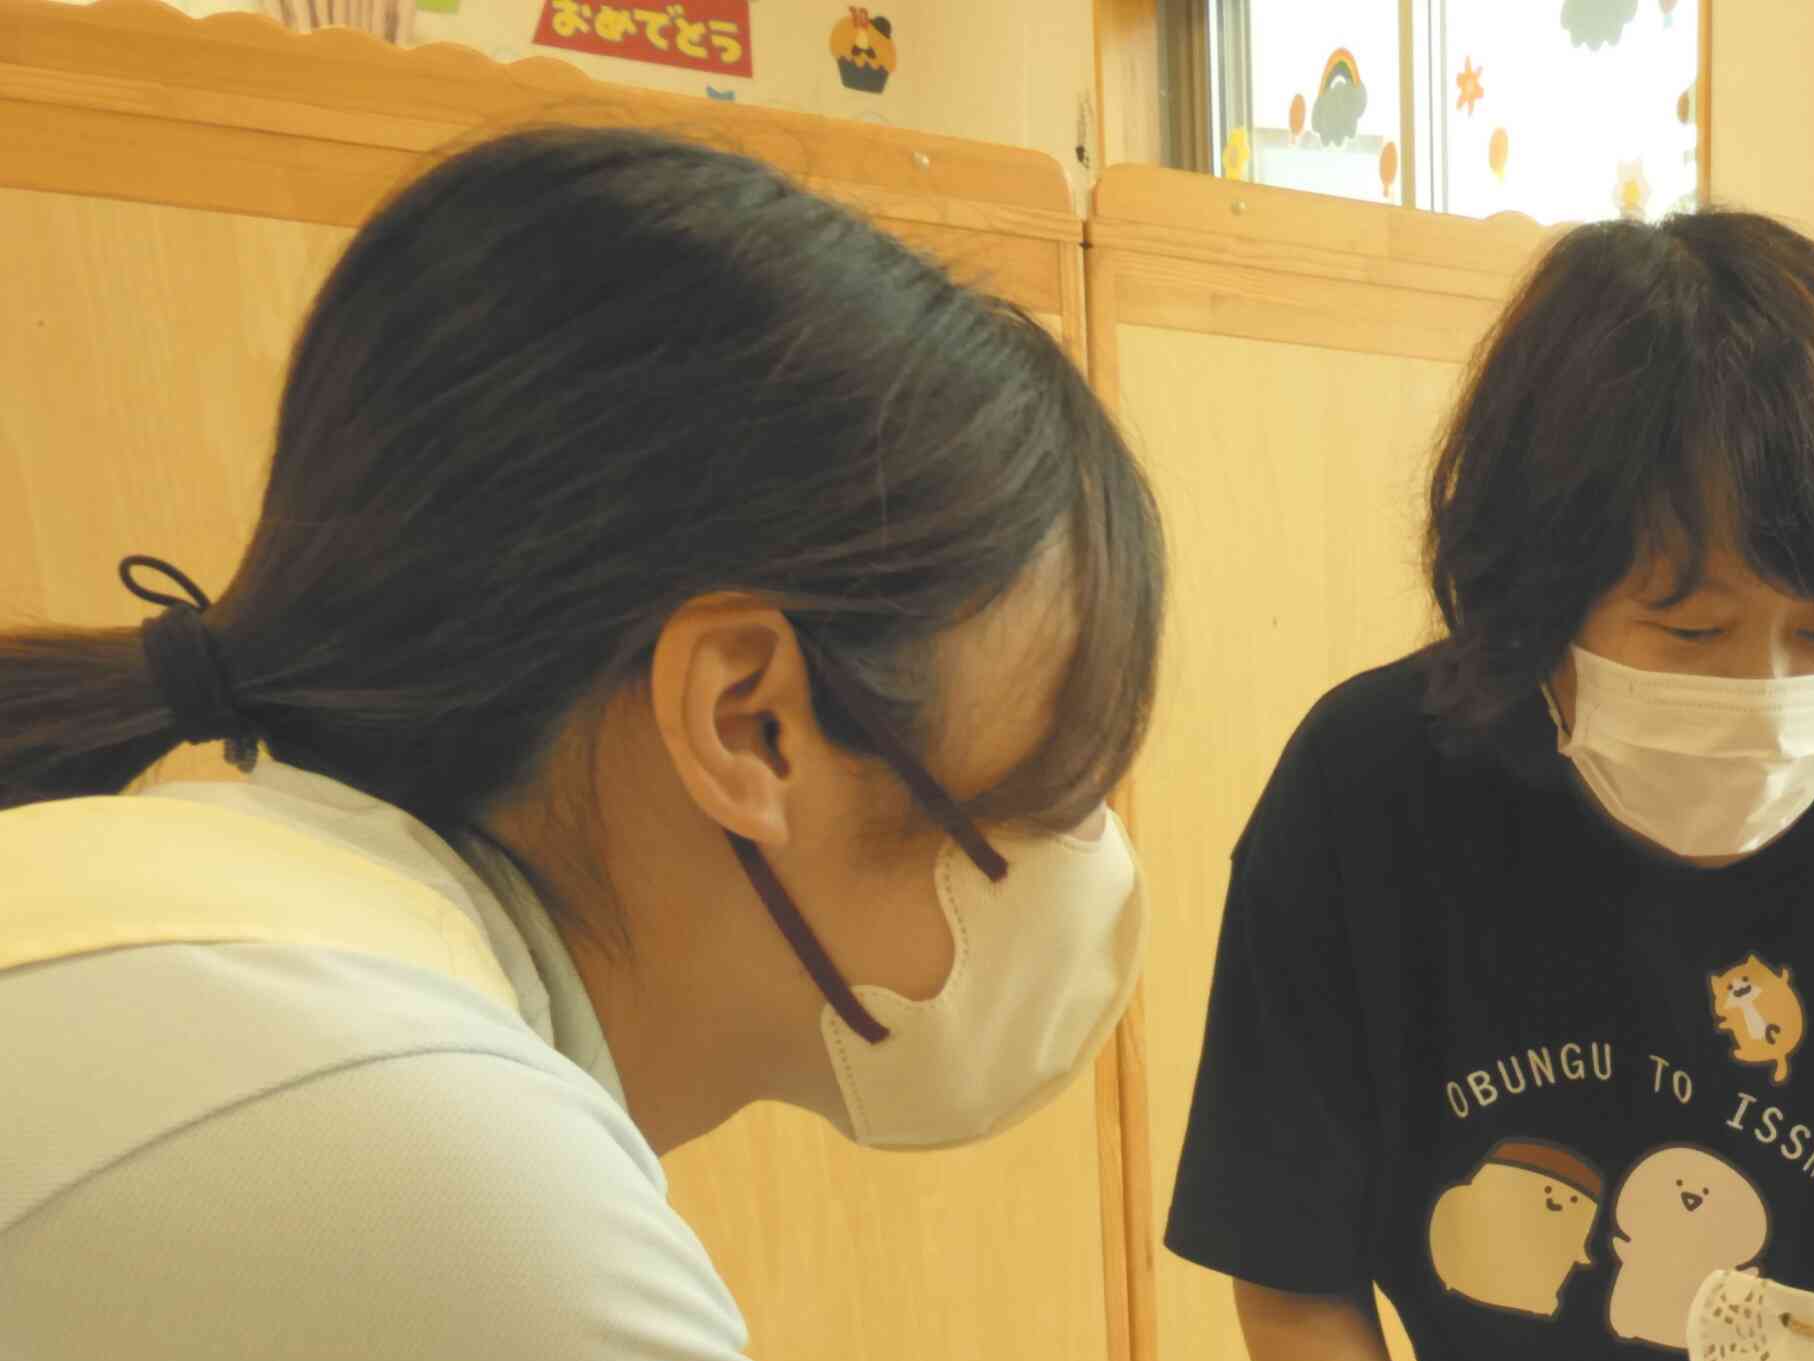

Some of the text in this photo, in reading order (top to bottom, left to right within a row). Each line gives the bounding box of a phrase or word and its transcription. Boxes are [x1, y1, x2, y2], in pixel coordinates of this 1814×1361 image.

[552, 0, 743, 65] おめでとう
[1445, 1040, 1613, 1120] OBUNGU
[1648, 1054, 1694, 1104] TO
